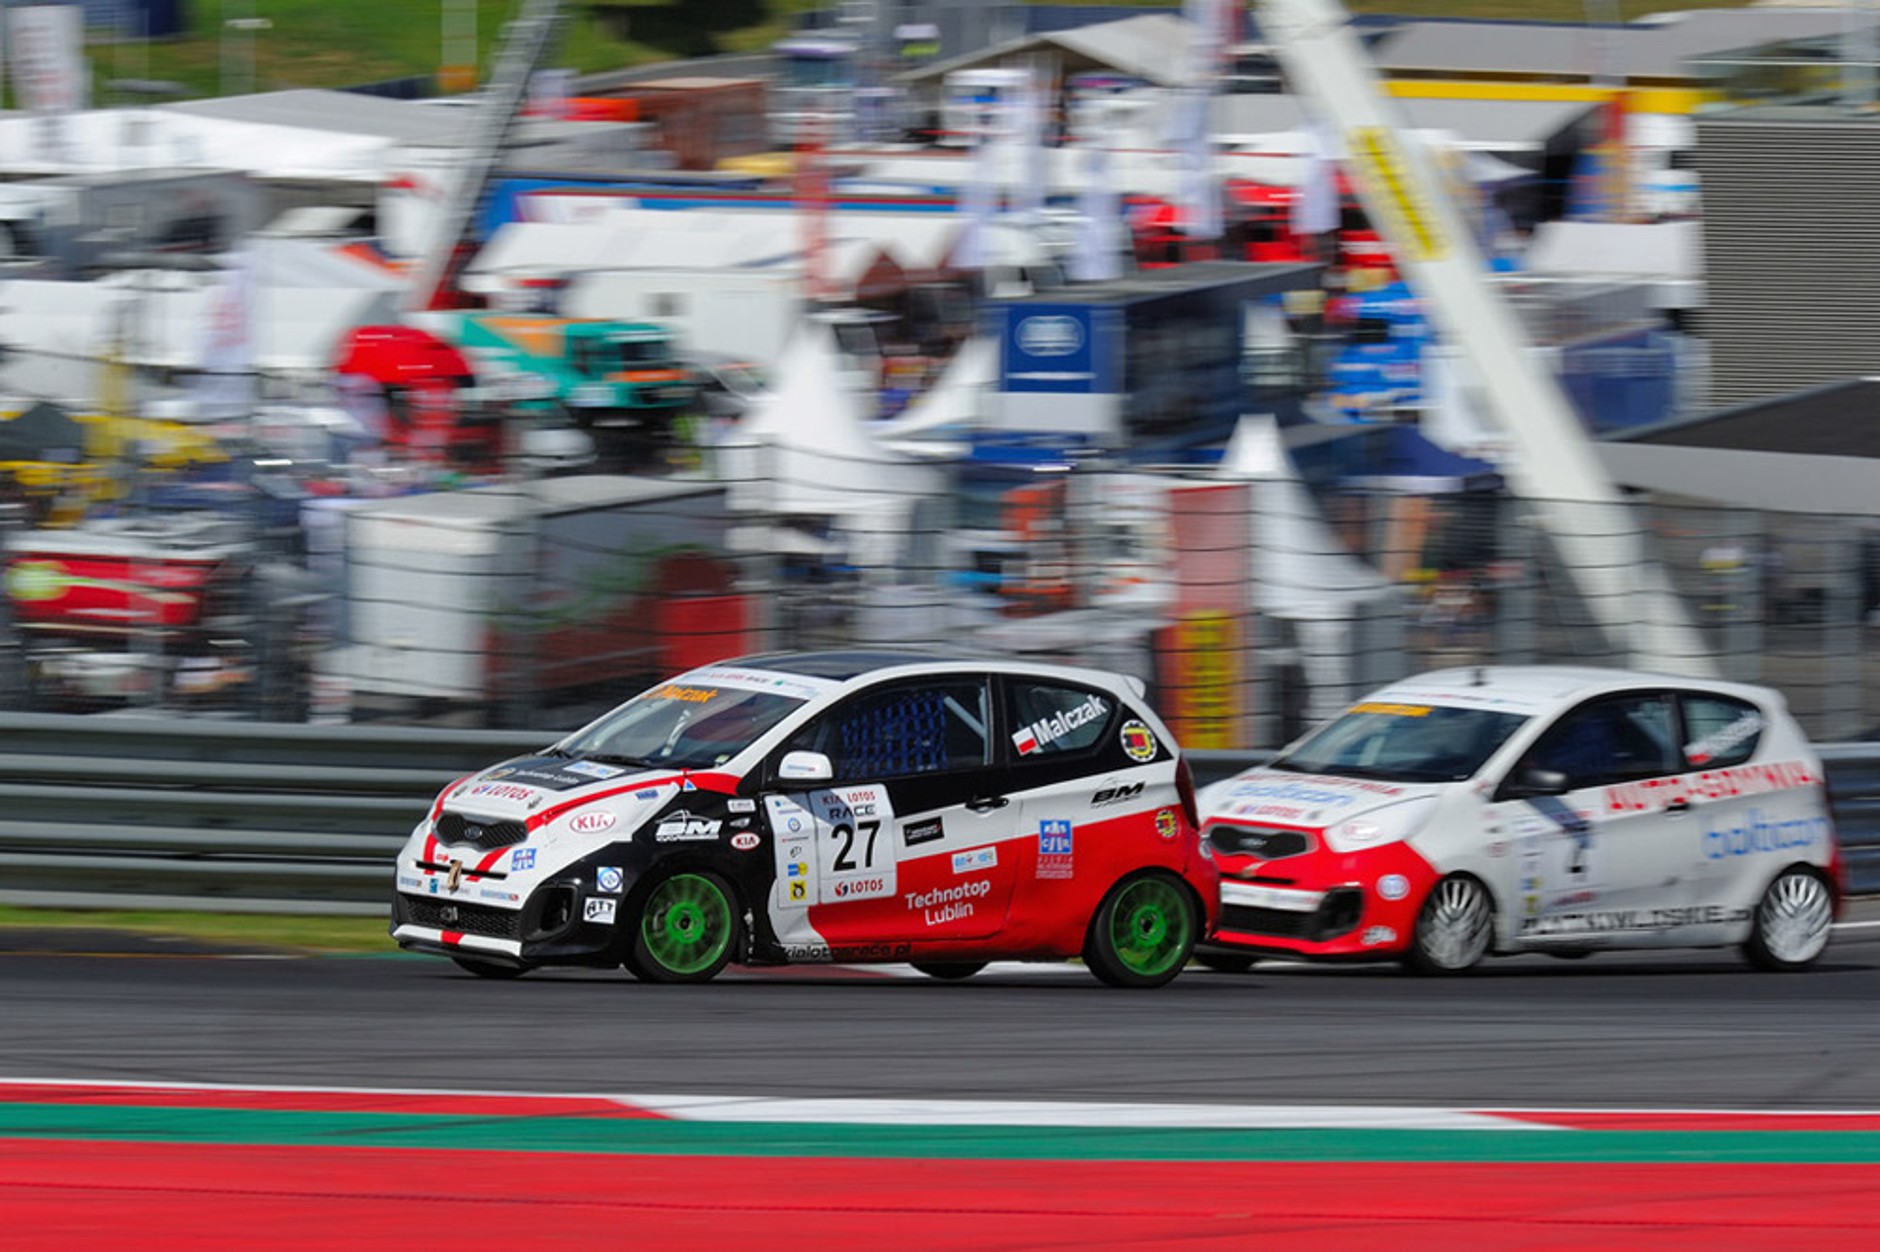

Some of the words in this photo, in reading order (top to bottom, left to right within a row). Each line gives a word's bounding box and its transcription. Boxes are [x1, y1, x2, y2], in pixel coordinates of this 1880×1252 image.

[1032, 694, 1108, 745] Malczak
[847, 791, 876, 803] LOTOS
[829, 804, 876, 819] RACE
[577, 814, 609, 830] KIA
[735, 836, 756, 847] KIA
[831, 819, 881, 872] 27
[850, 879, 883, 894] LOTOS
[905, 880, 990, 910] Technotop
[925, 902, 974, 926] Lublin
